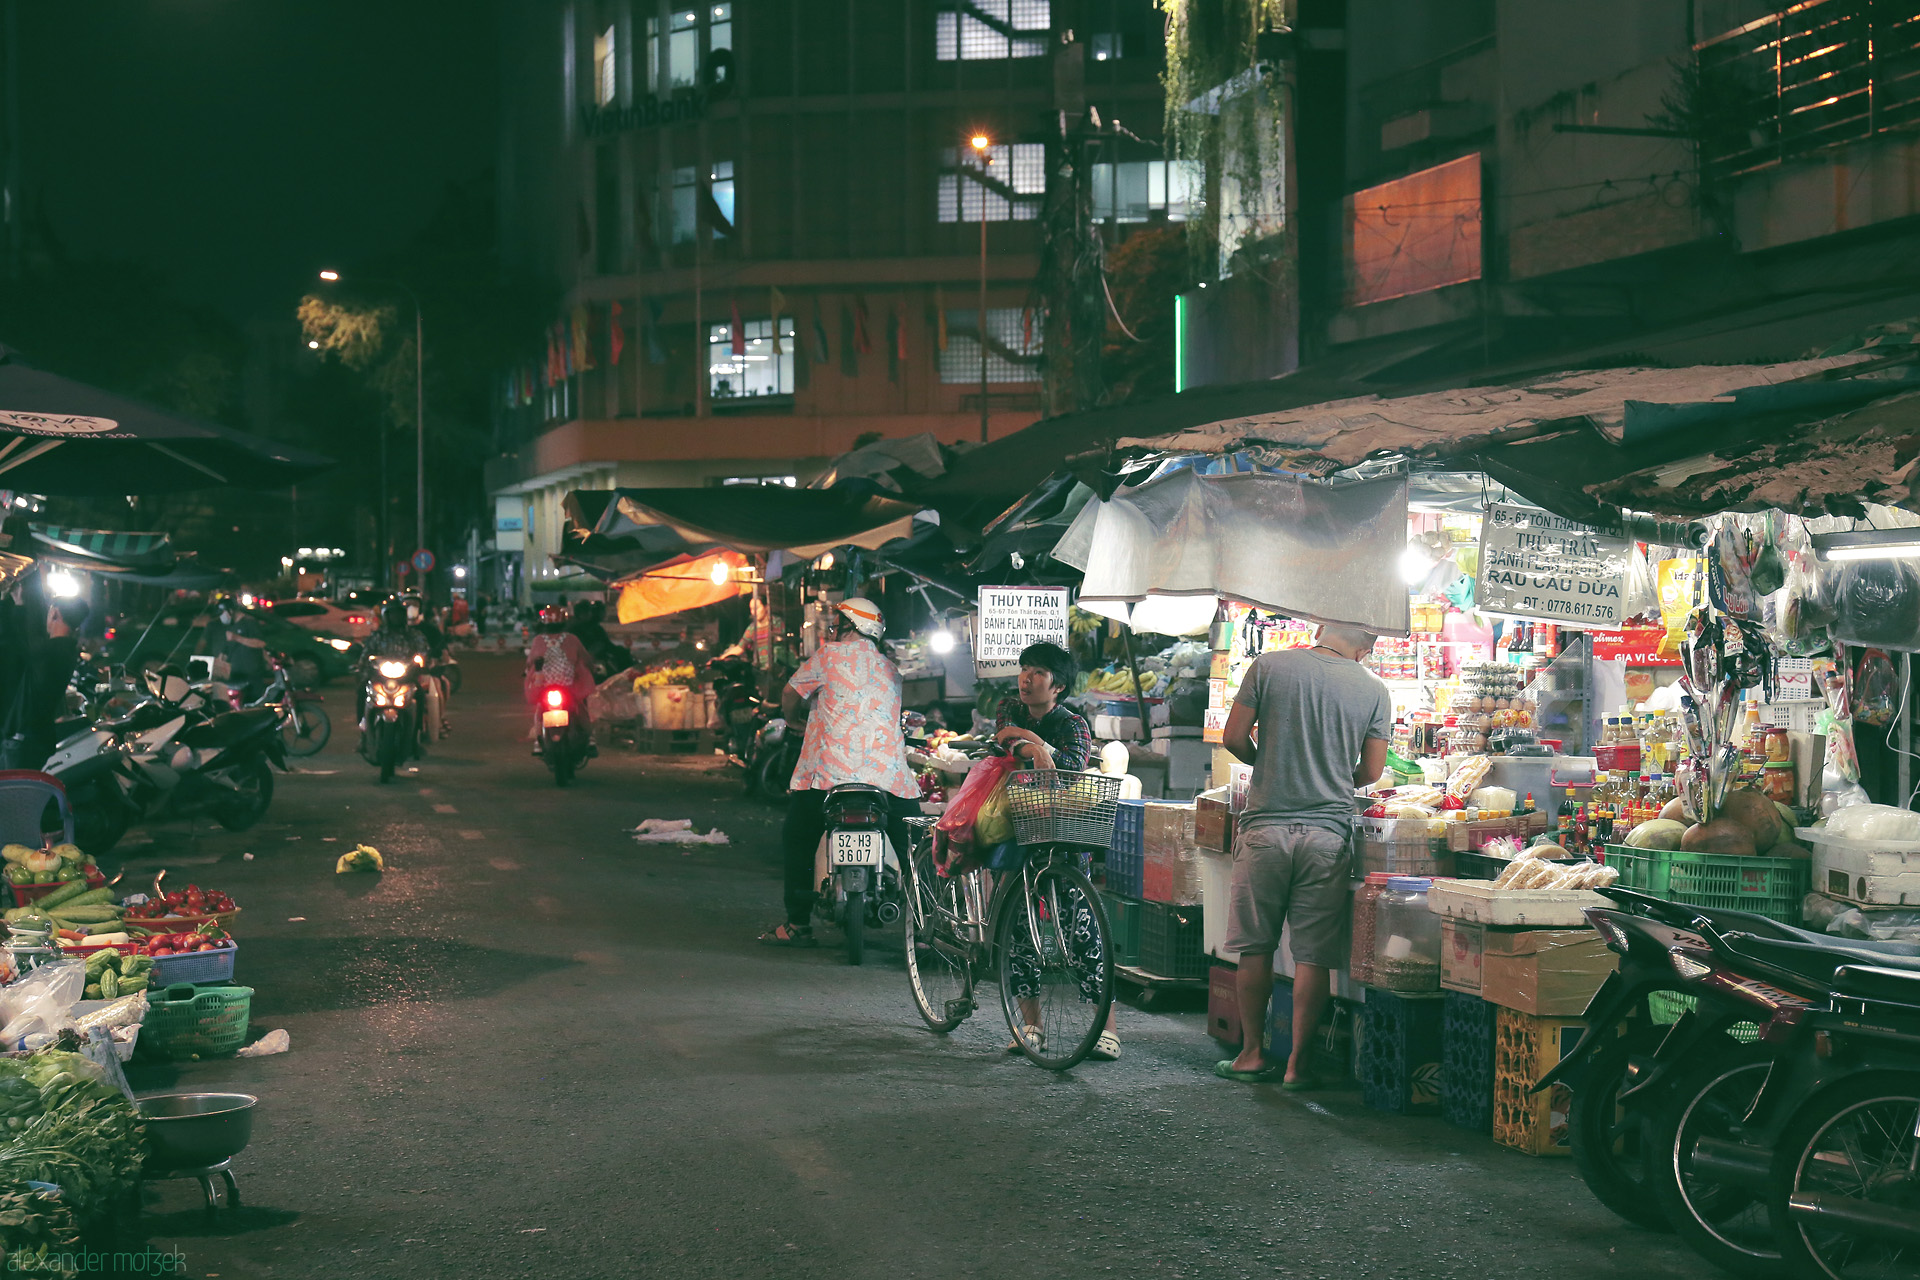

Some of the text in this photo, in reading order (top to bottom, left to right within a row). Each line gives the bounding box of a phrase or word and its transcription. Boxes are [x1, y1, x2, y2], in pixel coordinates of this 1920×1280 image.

[1494, 509, 1507, 522] 65
[1529, 513, 1550, 528] TÔN
[1560, 535, 1600, 558] TRÂN
[1488, 546, 1524, 568] BÁNH
[1488, 570, 1527, 586] RAU
[1578, 579, 1620, 598] DỪA
[990, 592, 1059, 608] THÚY TRÂN
[1547, 599, 1614, 619] 0778.617.576
[984, 614, 1065, 631] BÁNH FLAN TRÁI DỪA
[984, 633, 1002, 645] RAU
[1004, 630, 1022, 646] CÂU
[1614, 653, 1633, 662] GIA
[838, 849, 871, 862] 3607
